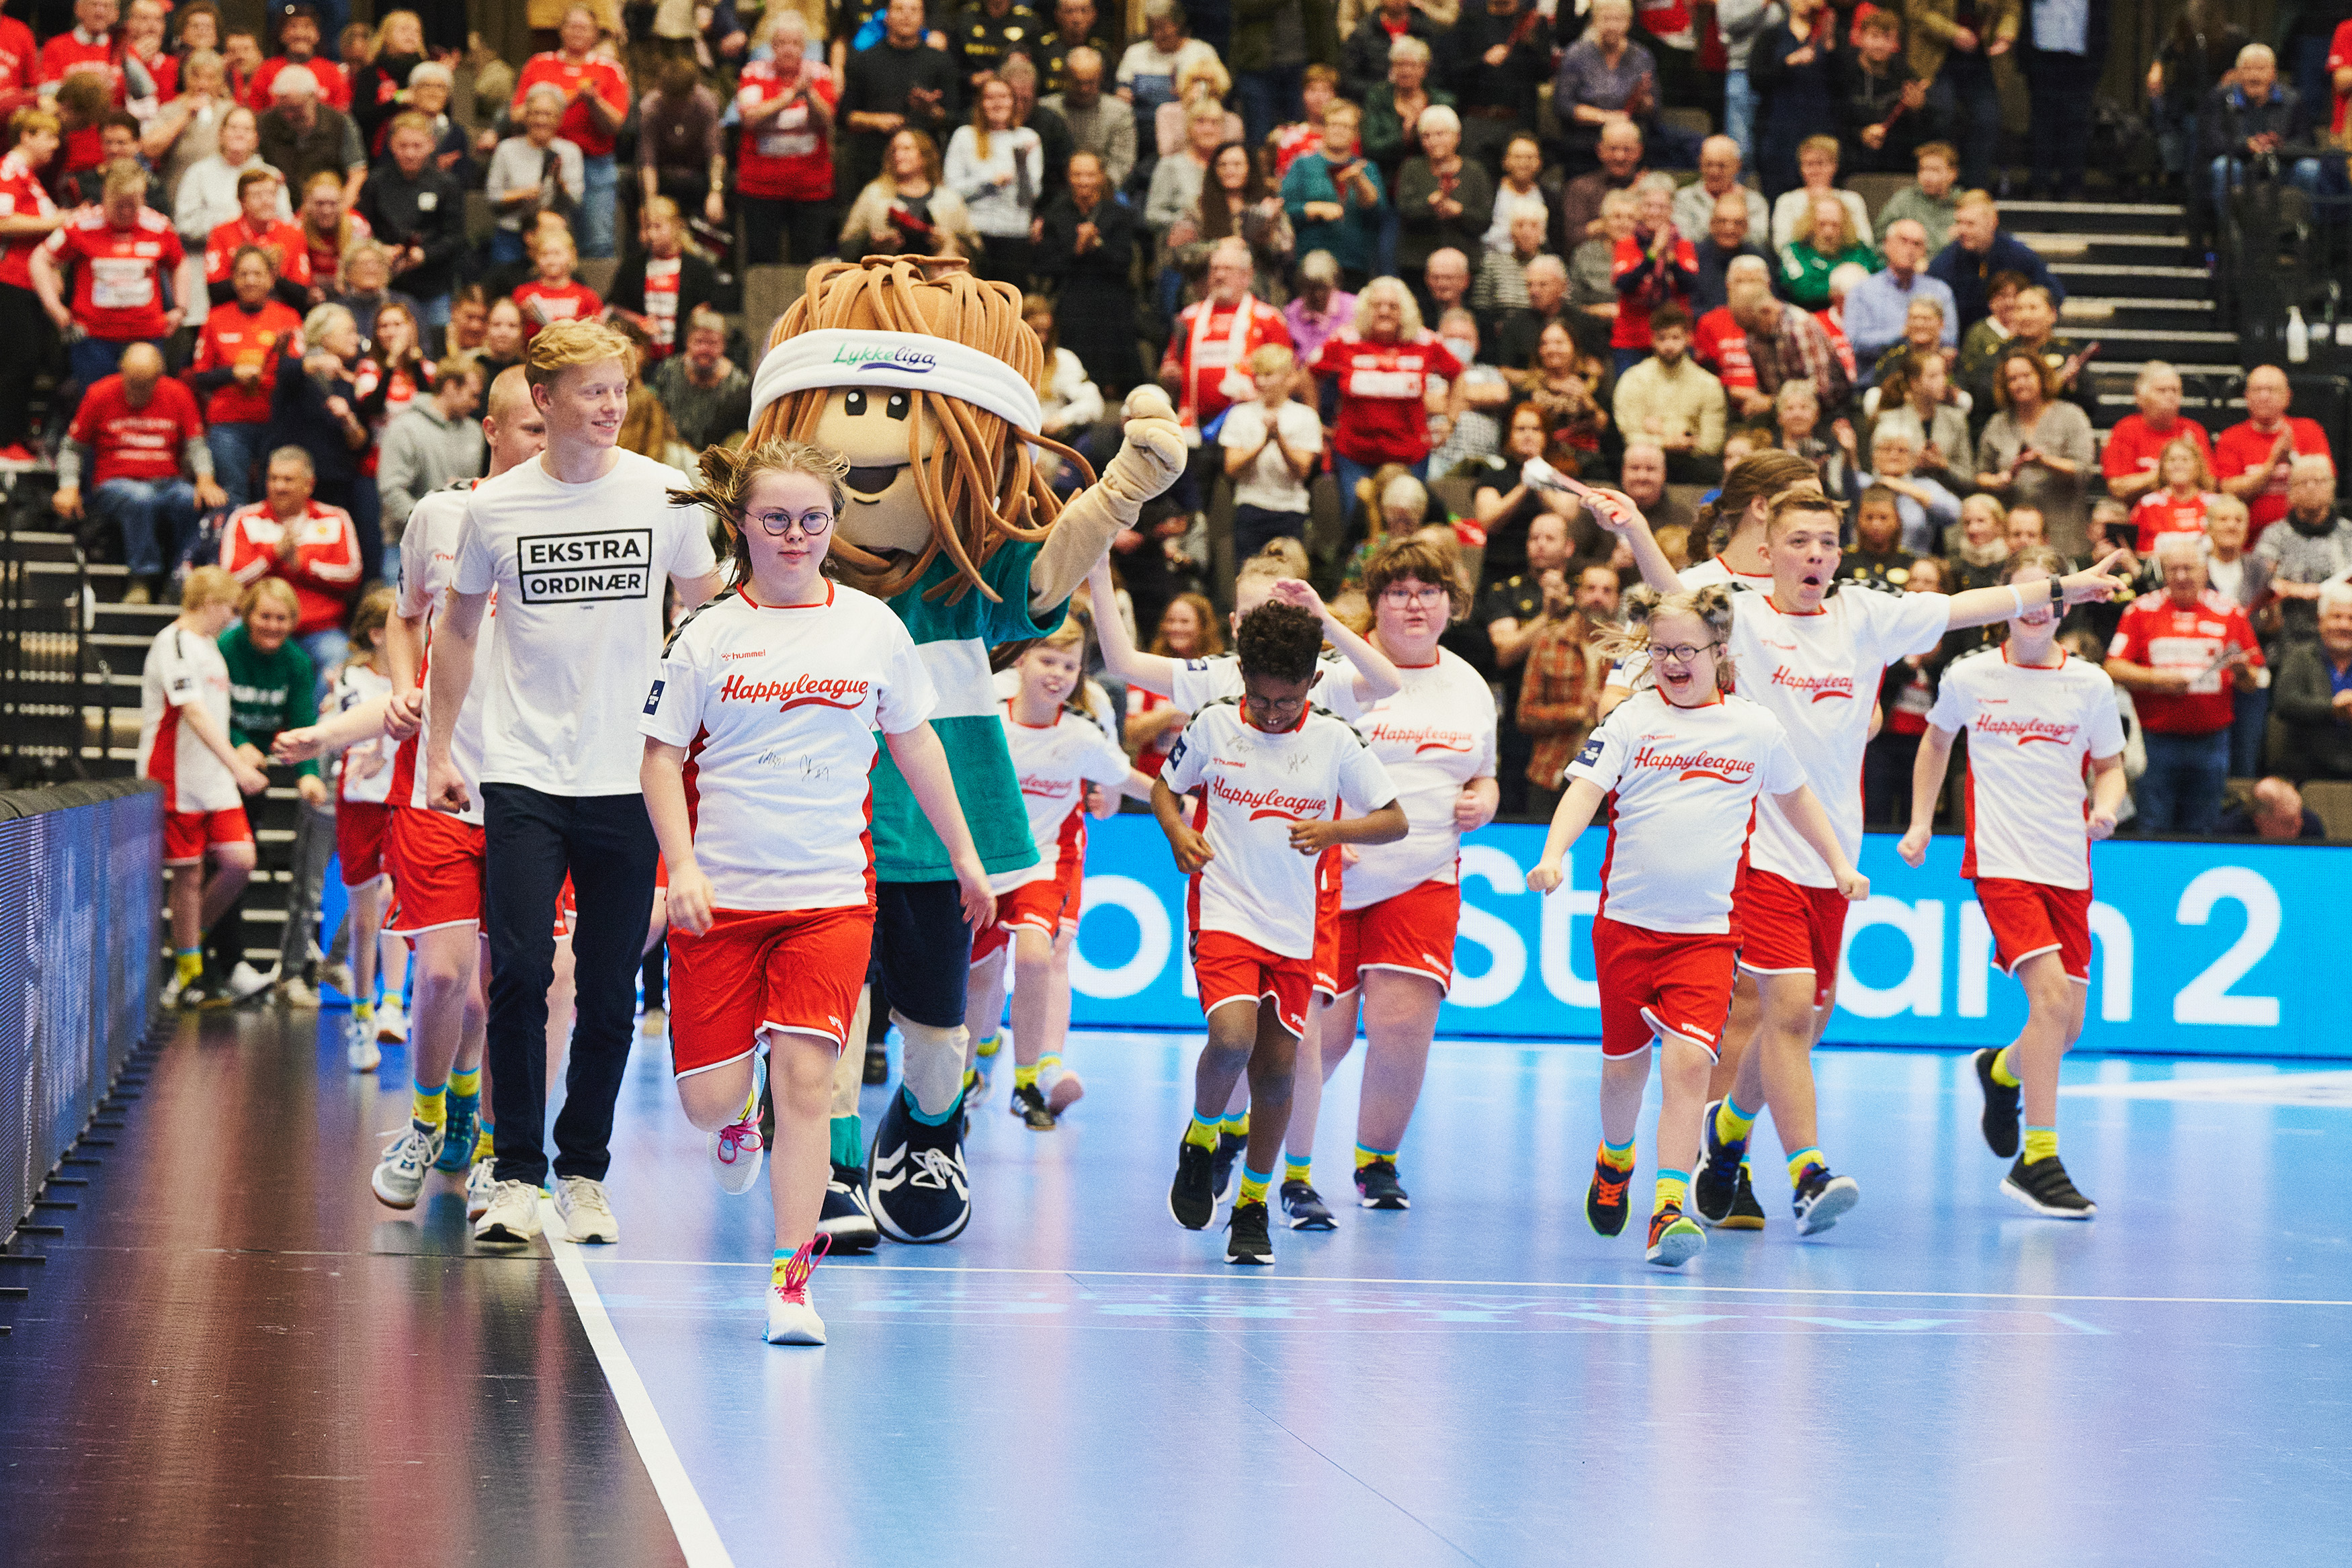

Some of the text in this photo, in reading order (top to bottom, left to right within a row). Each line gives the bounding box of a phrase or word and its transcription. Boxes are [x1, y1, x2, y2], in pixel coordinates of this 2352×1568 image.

[833, 343, 935, 366] Lykkeliga
[530, 539, 641, 564] EKSTRA
[531, 574, 641, 594] ORDINÆR
[732, 649, 766, 660] hummel
[721, 673, 869, 704] Happyleague
[1634, 746, 1755, 775] Happyleague
[1214, 775, 1327, 814] Happyleague
[2172, 865, 2281, 1027] 2
